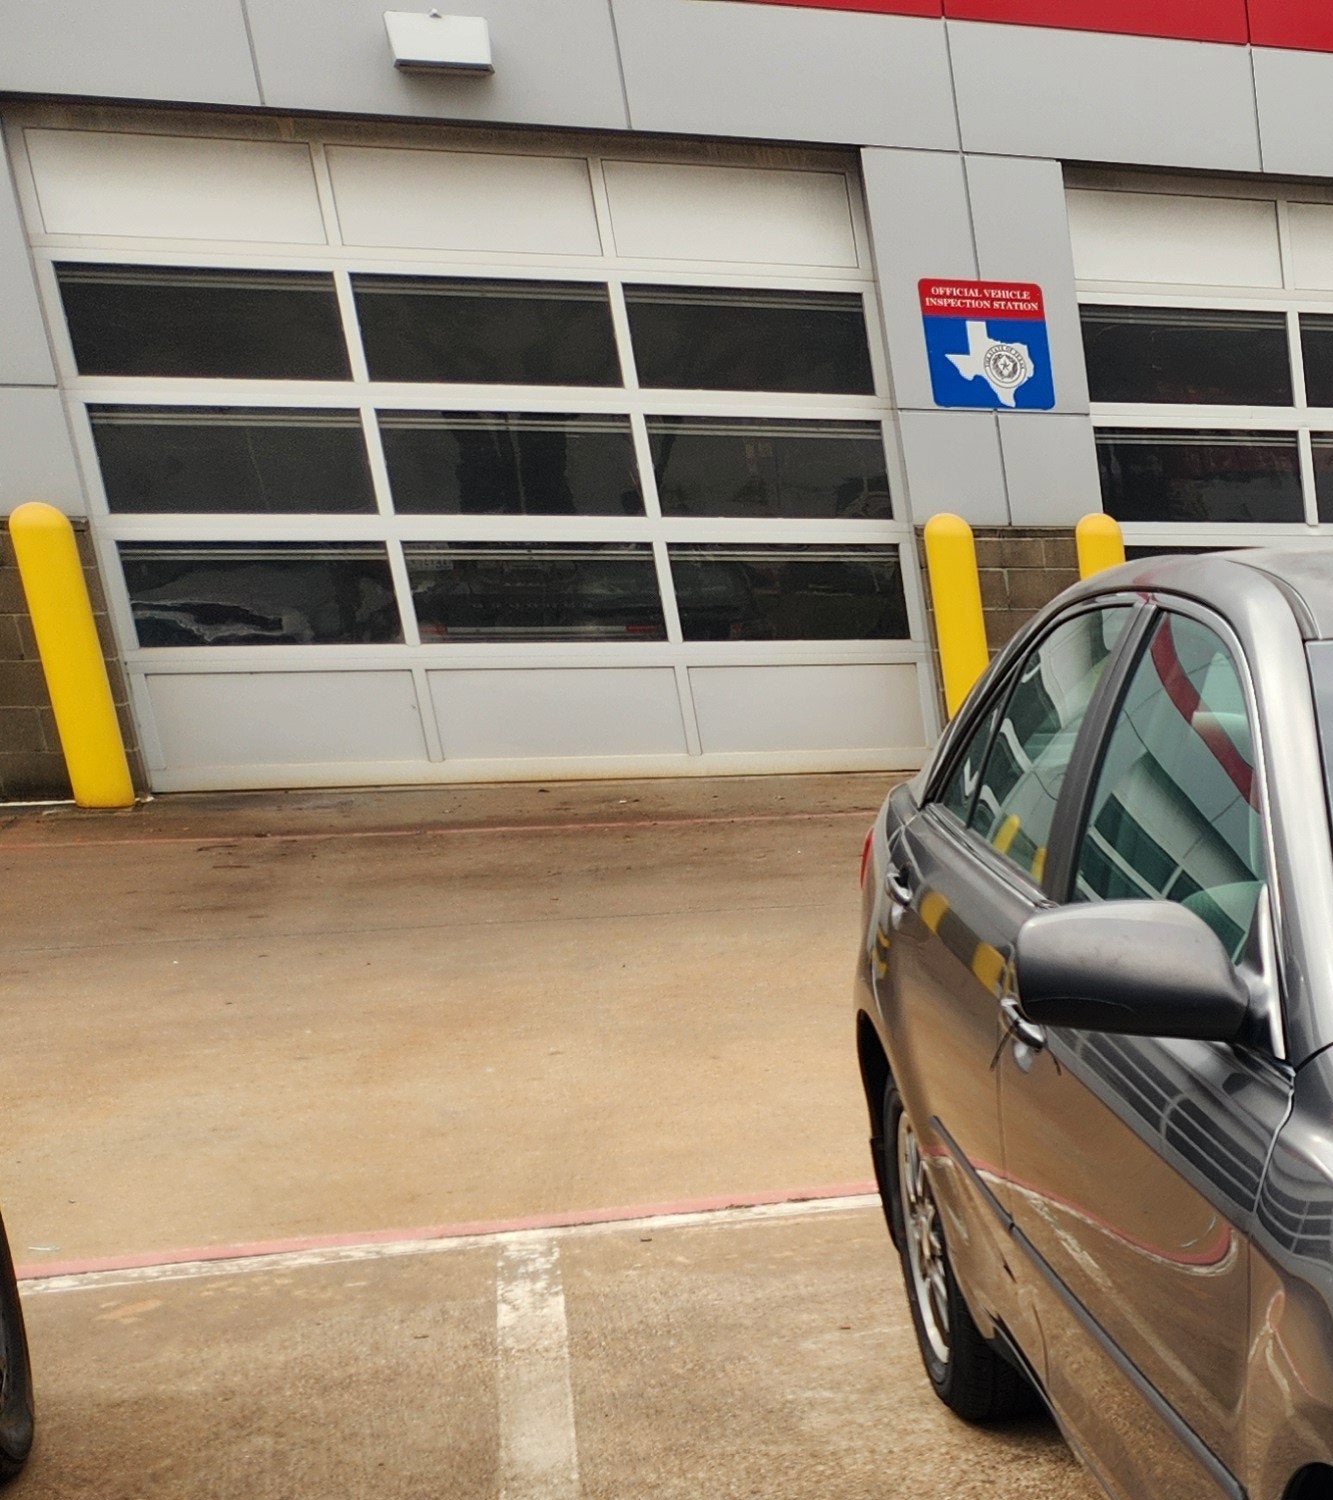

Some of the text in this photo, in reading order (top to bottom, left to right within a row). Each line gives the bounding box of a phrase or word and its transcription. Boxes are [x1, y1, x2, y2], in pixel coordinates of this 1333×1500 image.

[931, 286, 1031, 300] OFFICIAL VEHICLE
[925, 297, 1039, 311] INSPECTION STATION
